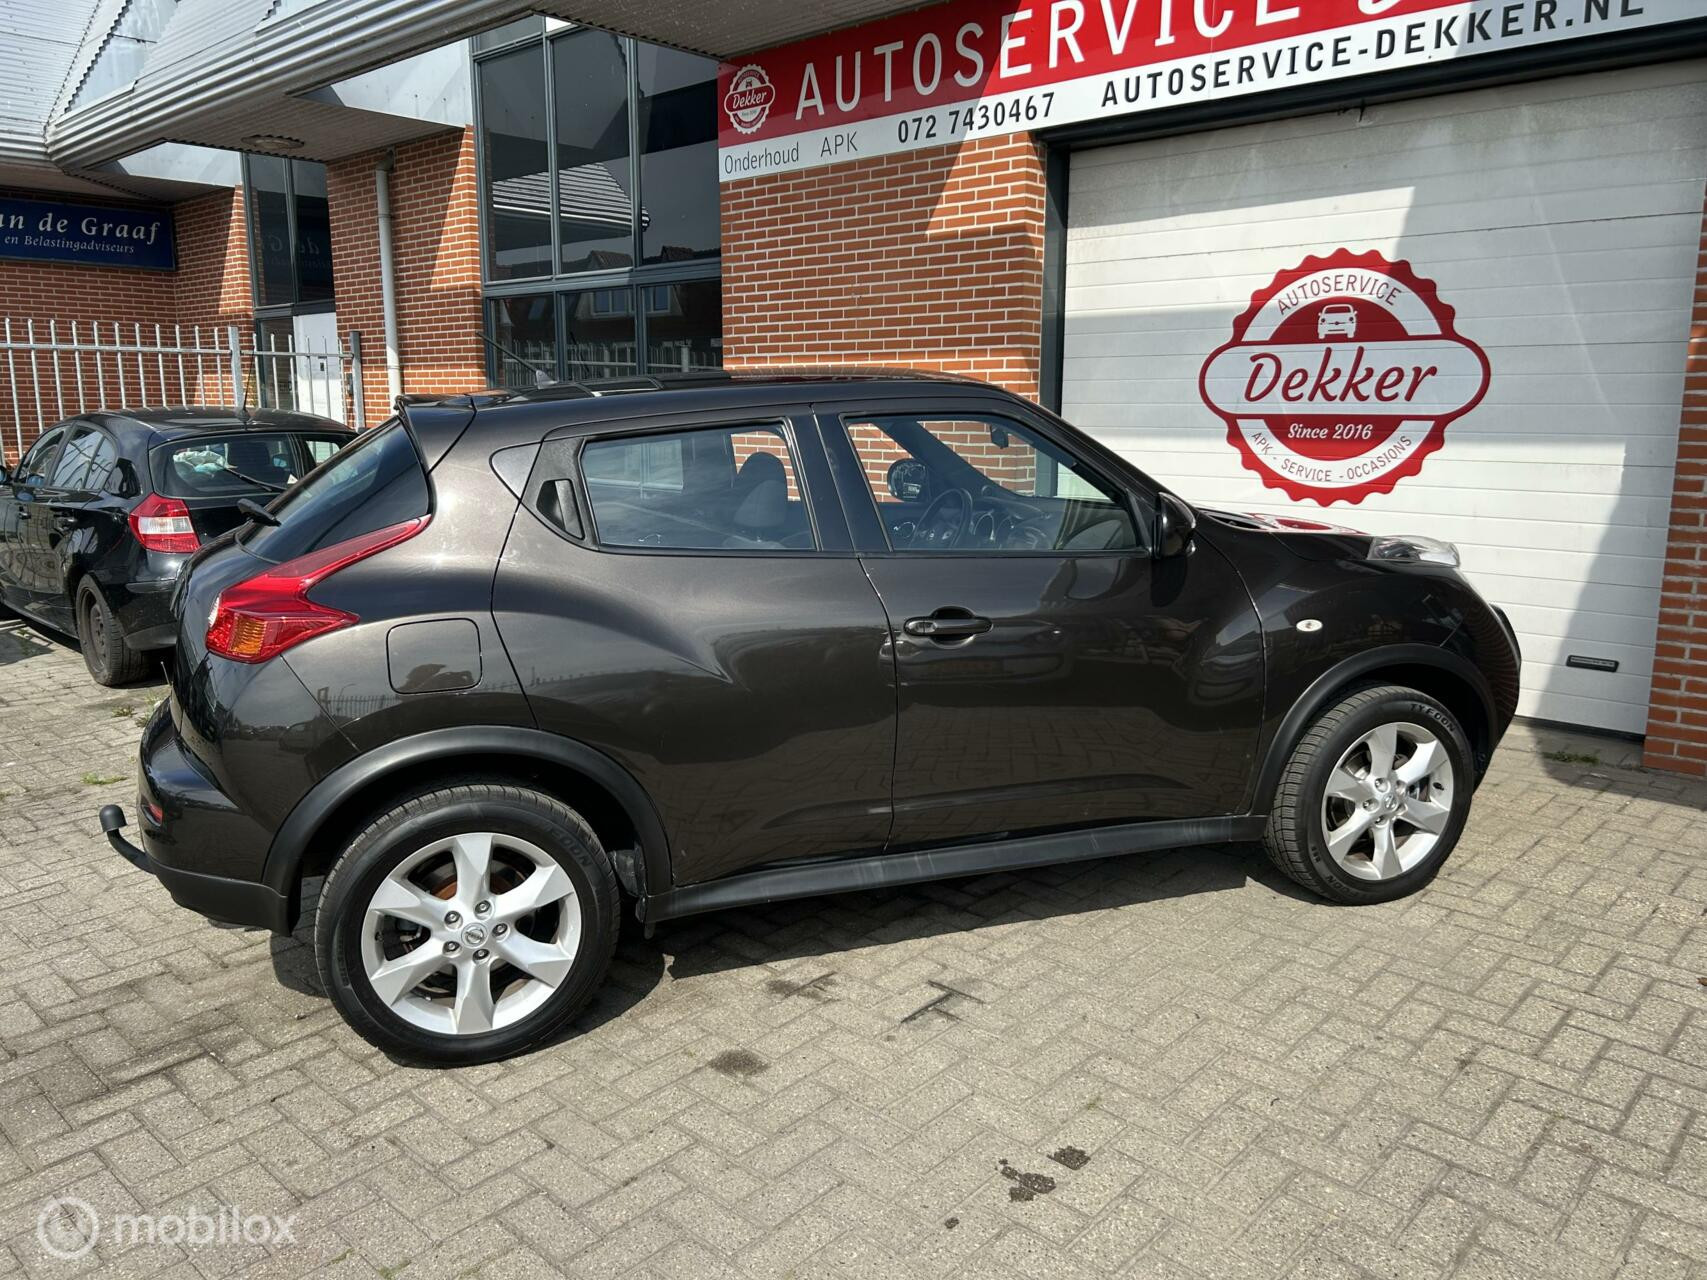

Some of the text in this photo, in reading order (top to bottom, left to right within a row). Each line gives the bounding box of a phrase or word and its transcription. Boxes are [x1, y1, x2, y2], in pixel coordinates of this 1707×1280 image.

[1102, 0, 1644, 107] AUTOSERVICE-DEKKER.NL
[733, 89, 767, 109] Dekker
[897, 92, 1055, 144] 072 7430467
[724, 131, 858, 174] Onderhoud APK
[4, 235, 136, 255] en Belastingadviseurs
[38, 212, 69, 233] de
[81, 217, 161, 245] Graaf
[1276, 274, 1402, 316] AUTOSERVICE
[1244, 345, 1438, 402] Dekker
[1287, 422, 1374, 440] Since 2016
[1251, 431, 1271, 456] APK
[1280, 458, 1333, 483] SERVICE
[1346, 435, 1413, 481] OCCASIONS
